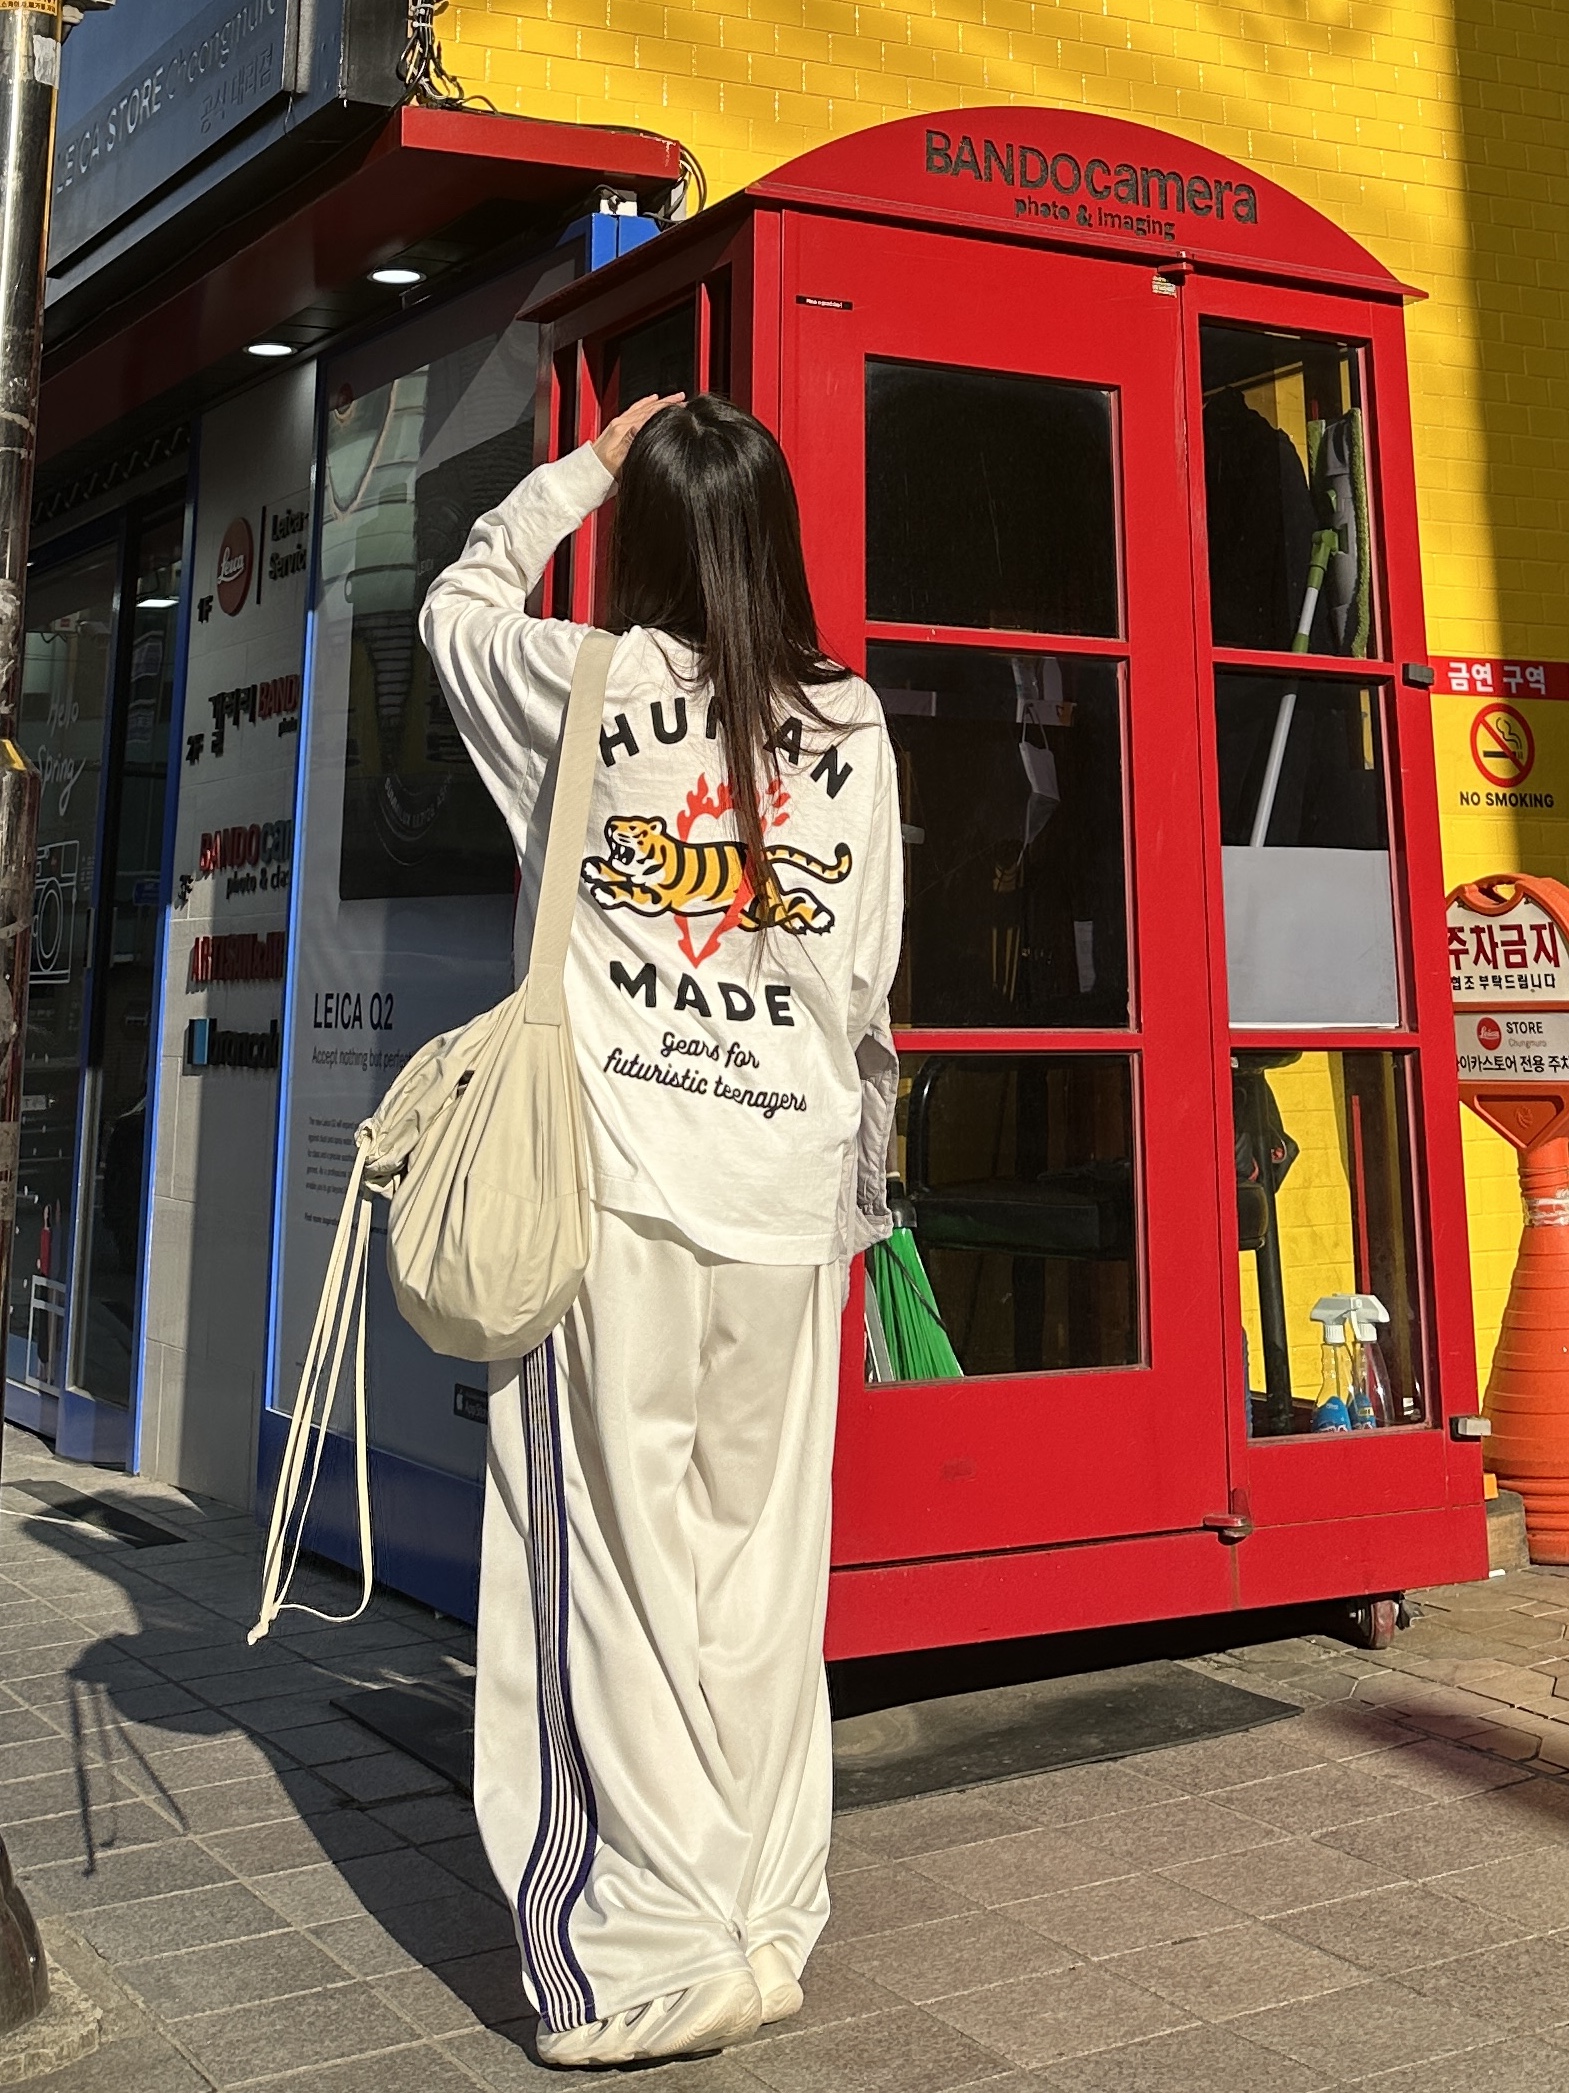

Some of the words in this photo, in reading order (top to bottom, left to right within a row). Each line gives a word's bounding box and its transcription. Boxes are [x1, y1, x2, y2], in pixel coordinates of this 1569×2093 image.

[201, 81, 227, 134] 공식
[231, 43, 274, 106] 대리점
[55, 122, 100, 194] LEICA
[106, 65, 164, 152] STORE
[925, 129, 1258, 224] BANDOcamera
[1014, 195, 1070, 220] photo
[1076, 204, 1093, 228] &
[268, 543, 308, 580] Servic
[258, 673, 301, 720] BAND
[1447, 661, 1494, 693] 금연
[1502, 665, 1546, 695] 구역
[38, 744, 87, 817] Spring
[1459, 790, 1481, 807] NO
[1485, 792, 1555, 809] SMOKING
[1447, 921, 1561, 970] 주차금지
[609, 960, 795, 1027] MADE
[1450, 975, 1475, 991] 협조
[1479, 973, 1556, 991] 부탁드립니다
[313, 992, 363, 1030] LEICA
[369, 992, 394, 1031] Q2
[1505, 1021, 1544, 1035] STORE
[369, 1049, 382, 1068] but
[724, 1041, 761, 1069] for
[1456, 1055, 1518, 1073] 이카스토어
[1520, 1055, 1545, 1073] 전용
[603, 1047, 708, 1095] futuristic
[713, 1075, 808, 1119] teenagers
